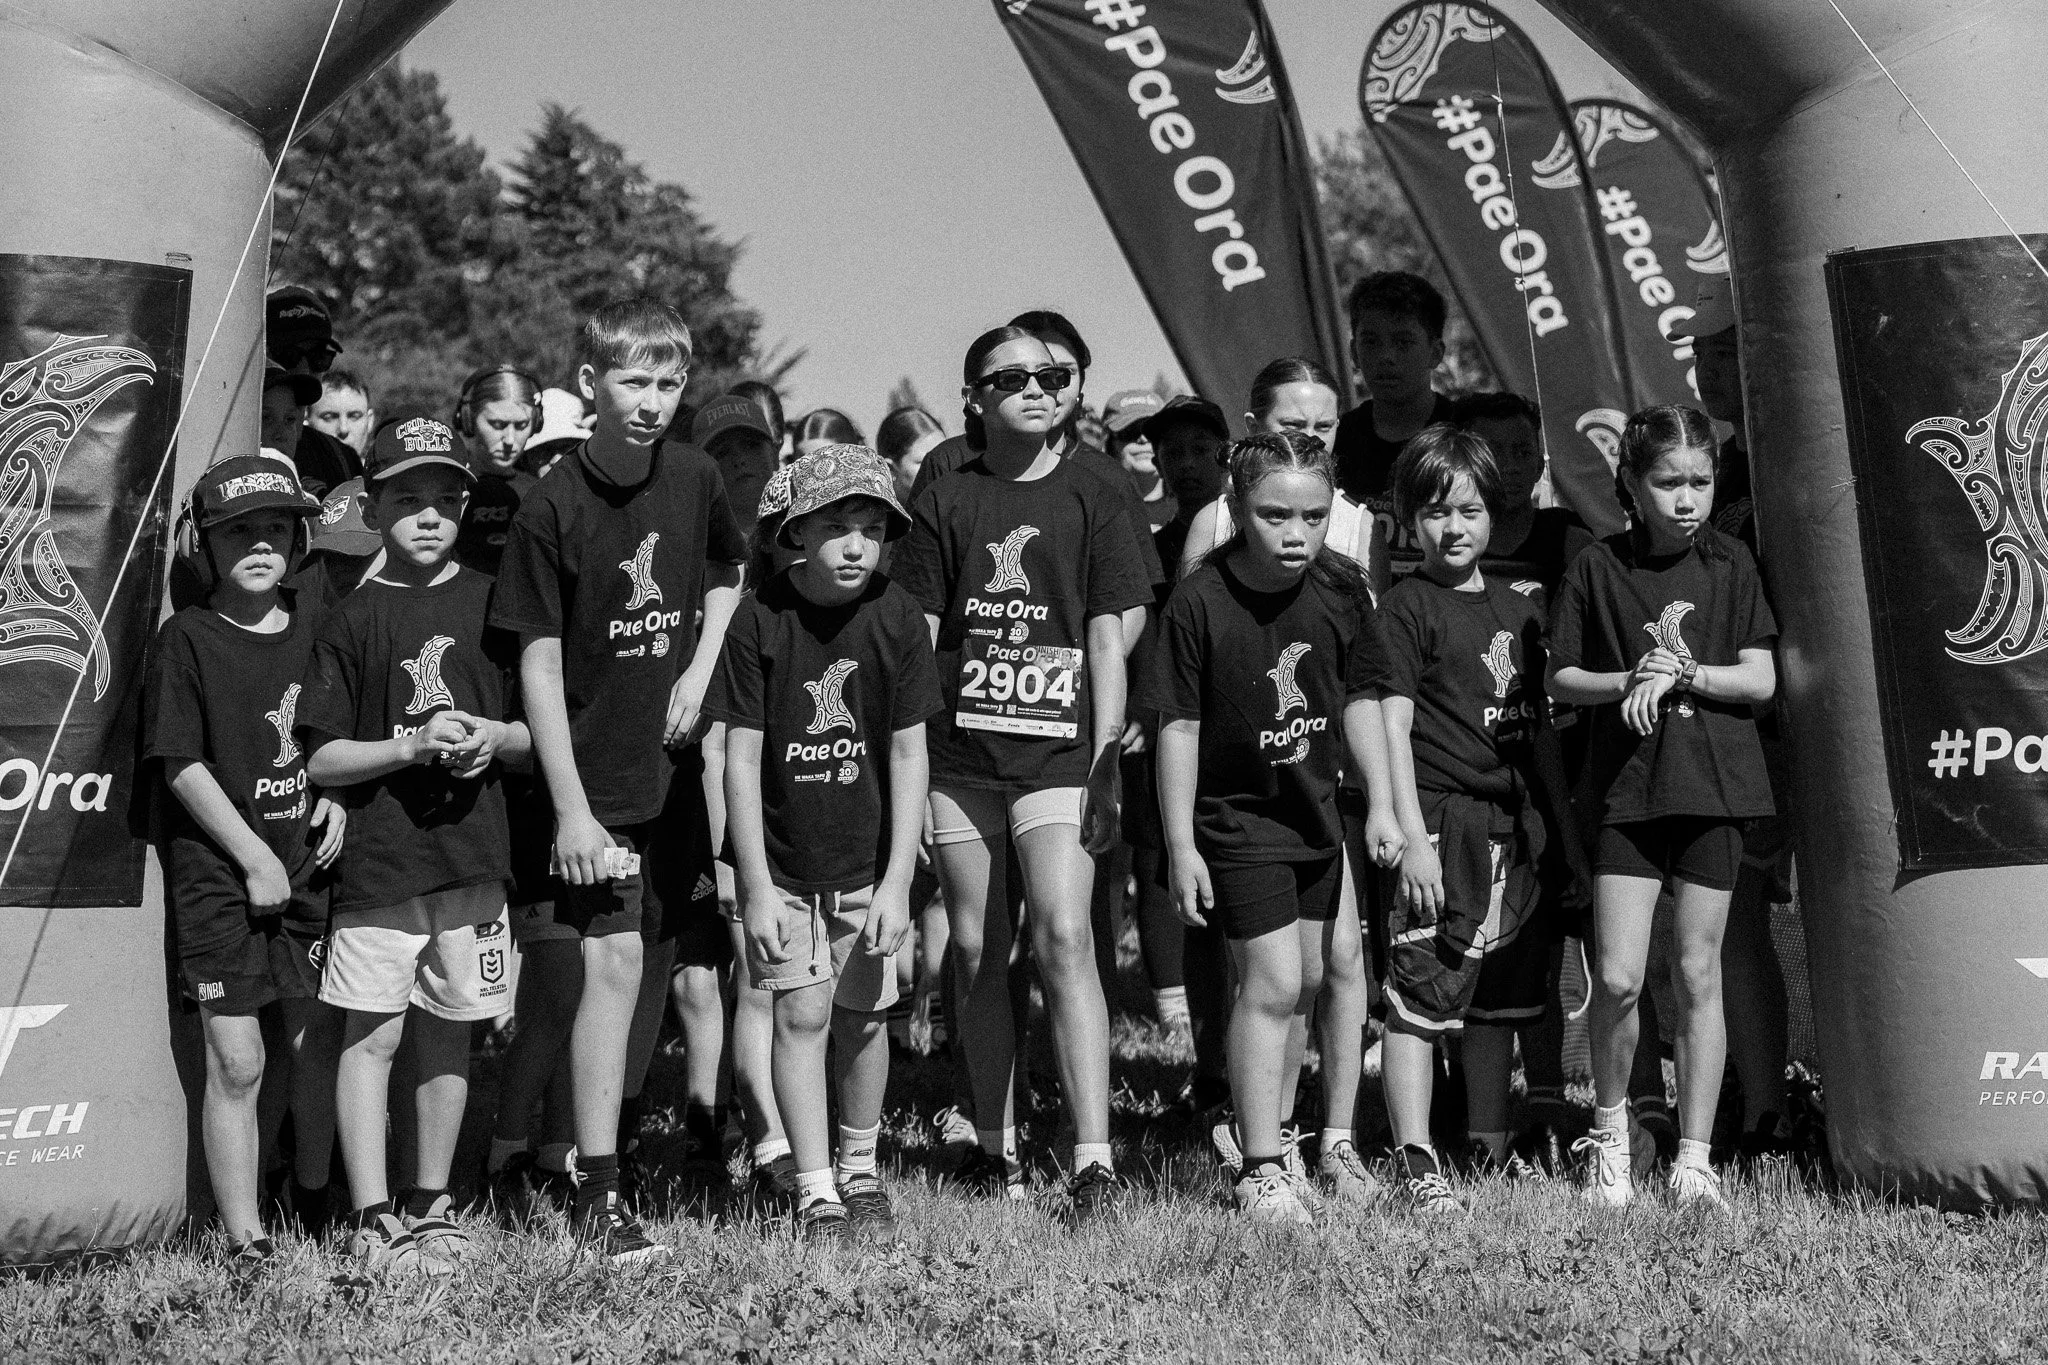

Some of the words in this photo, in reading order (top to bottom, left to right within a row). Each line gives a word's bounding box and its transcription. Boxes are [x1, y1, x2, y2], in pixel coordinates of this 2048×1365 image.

[1173, 155, 1266, 292] Ora
[1432, 94, 1516, 231] #Pae
[1499, 228, 1568, 337] Ora
[1596, 185, 1676, 307] #Pae
[706, 403, 751, 426] EVERLAST
[404, 436, 451, 452] BULLS
[965, 598, 1005, 618] Pae
[1006, 599, 1048, 620] Ora
[609, 619, 643, 639] Pae
[645, 610, 681, 632] Ora
[652, 640, 664, 650] 30
[986, 644, 1020, 661] Pae
[961, 659, 1076, 707] 2904
[1290, 717, 1328, 738] Ora
[785, 743, 831, 762] Pae
[1927, 726, 2048, 779] #Pa
[838, 767, 852, 777] 30
[0, 758, 112, 812] Ora
[255, 778, 296, 799] Pae
[691, 883, 716, 901] adidas
[206, 981, 225, 1000] NBA
[1979, 1051, 2048, 1080] RA
[1979, 1090, 2048, 1106] PERFO
[31, 1144, 85, 1164] WEAR
